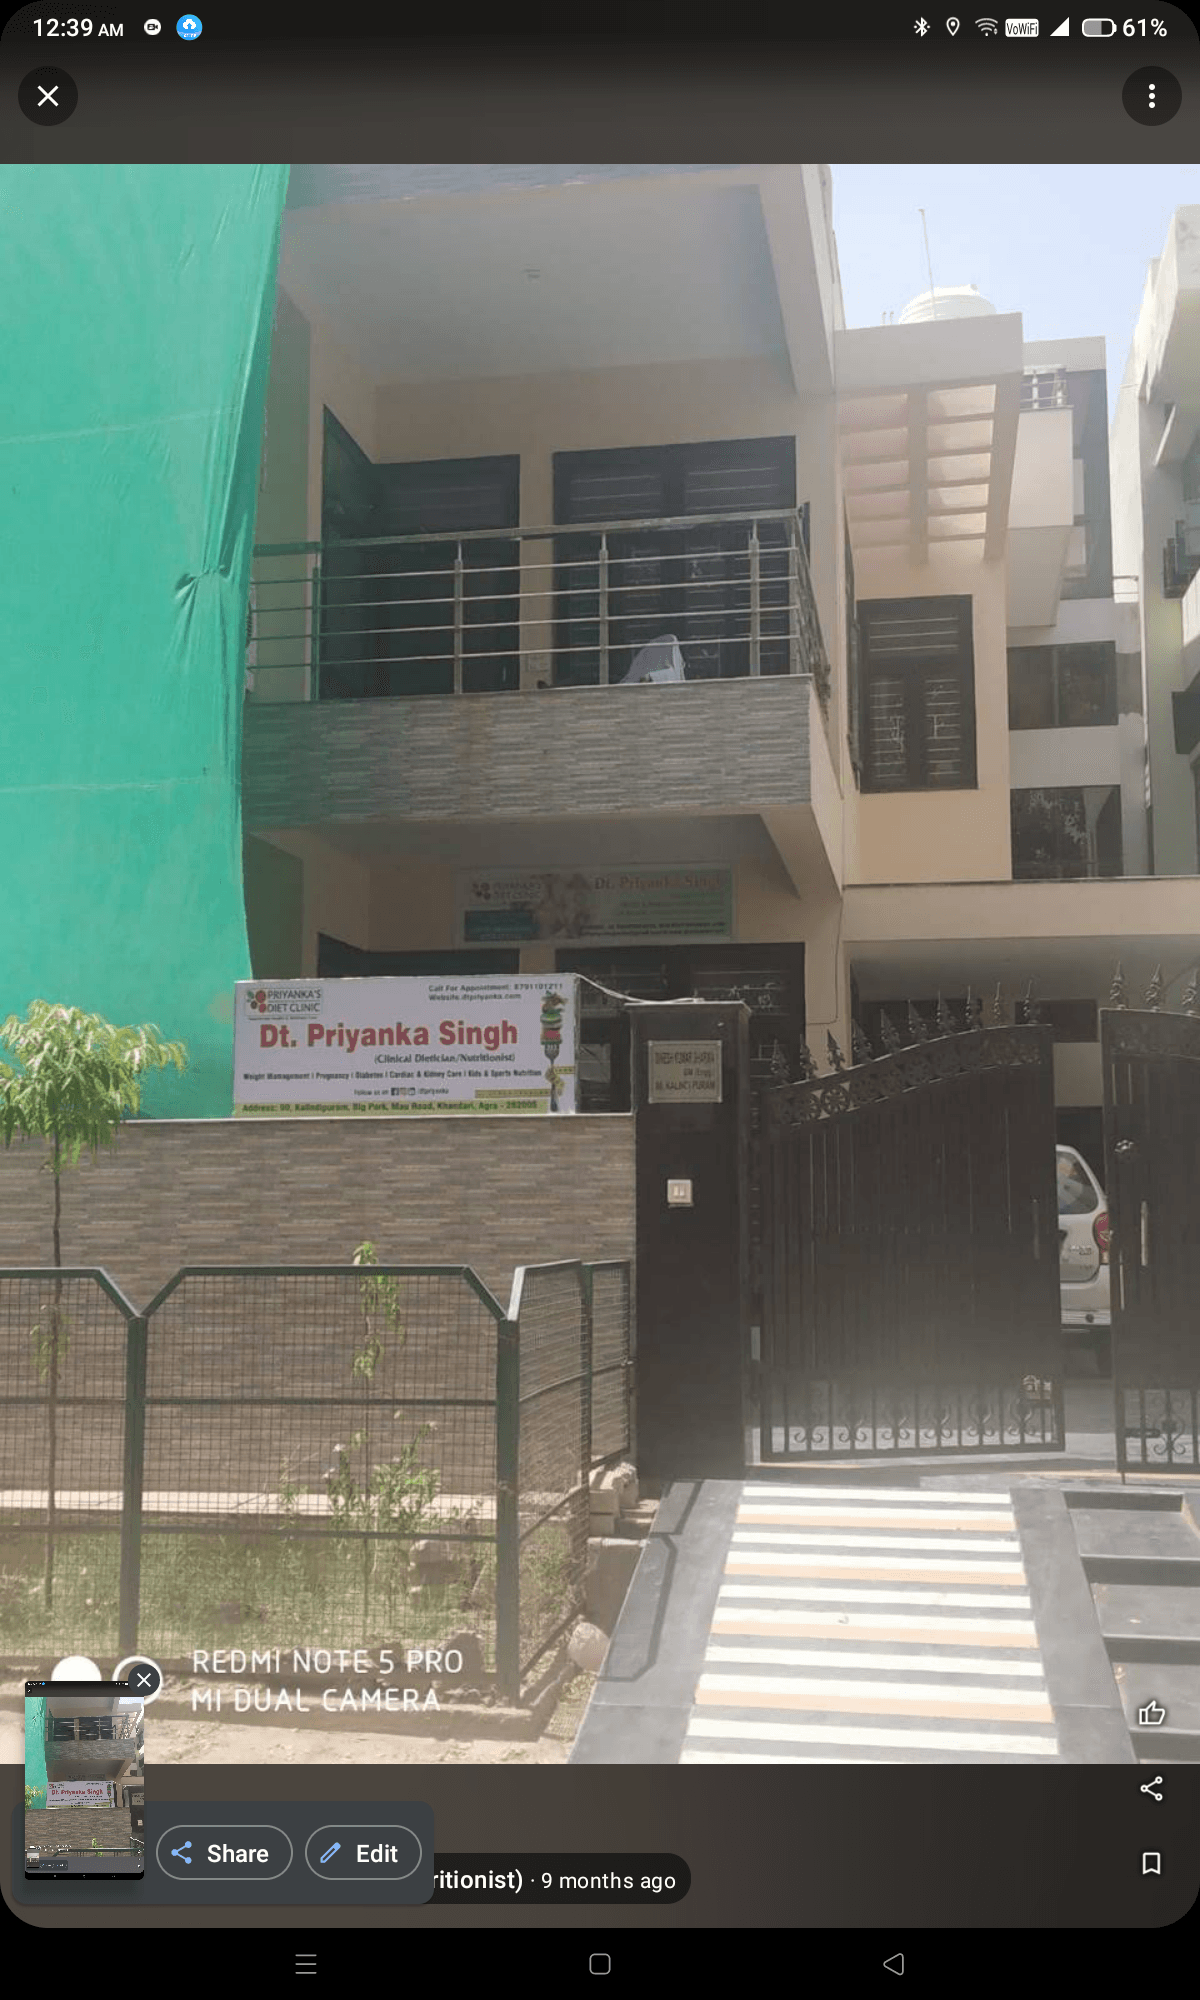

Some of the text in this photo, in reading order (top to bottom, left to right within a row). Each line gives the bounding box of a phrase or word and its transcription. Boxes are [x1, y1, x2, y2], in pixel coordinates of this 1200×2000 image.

[446, 984, 458, 992] For
[267, 989, 321, 999] PRIYANKA'S
[267, 1002, 321, 1013] DIET CLINIC
[260, 1019, 518, 1053] Dt. Priyanka Singh
[374, 1053, 412, 1064] (Clinical
[315, 1072, 349, 1081] Pregnancy
[355, 1071, 383, 1079] Diabetes
[389, 1071, 414, 1079] Cardiac
[423, 1070, 445, 1079] Kidney
[447, 1070, 462, 1078] Care
[468, 1069, 482, 1077] Kids
[491, 1069, 511, 1078] Sports
[513, 1069, 542, 1077] Nutrition
[352, 1103, 366, 1112] Big
[478, 1101, 499, 1110] Agra
